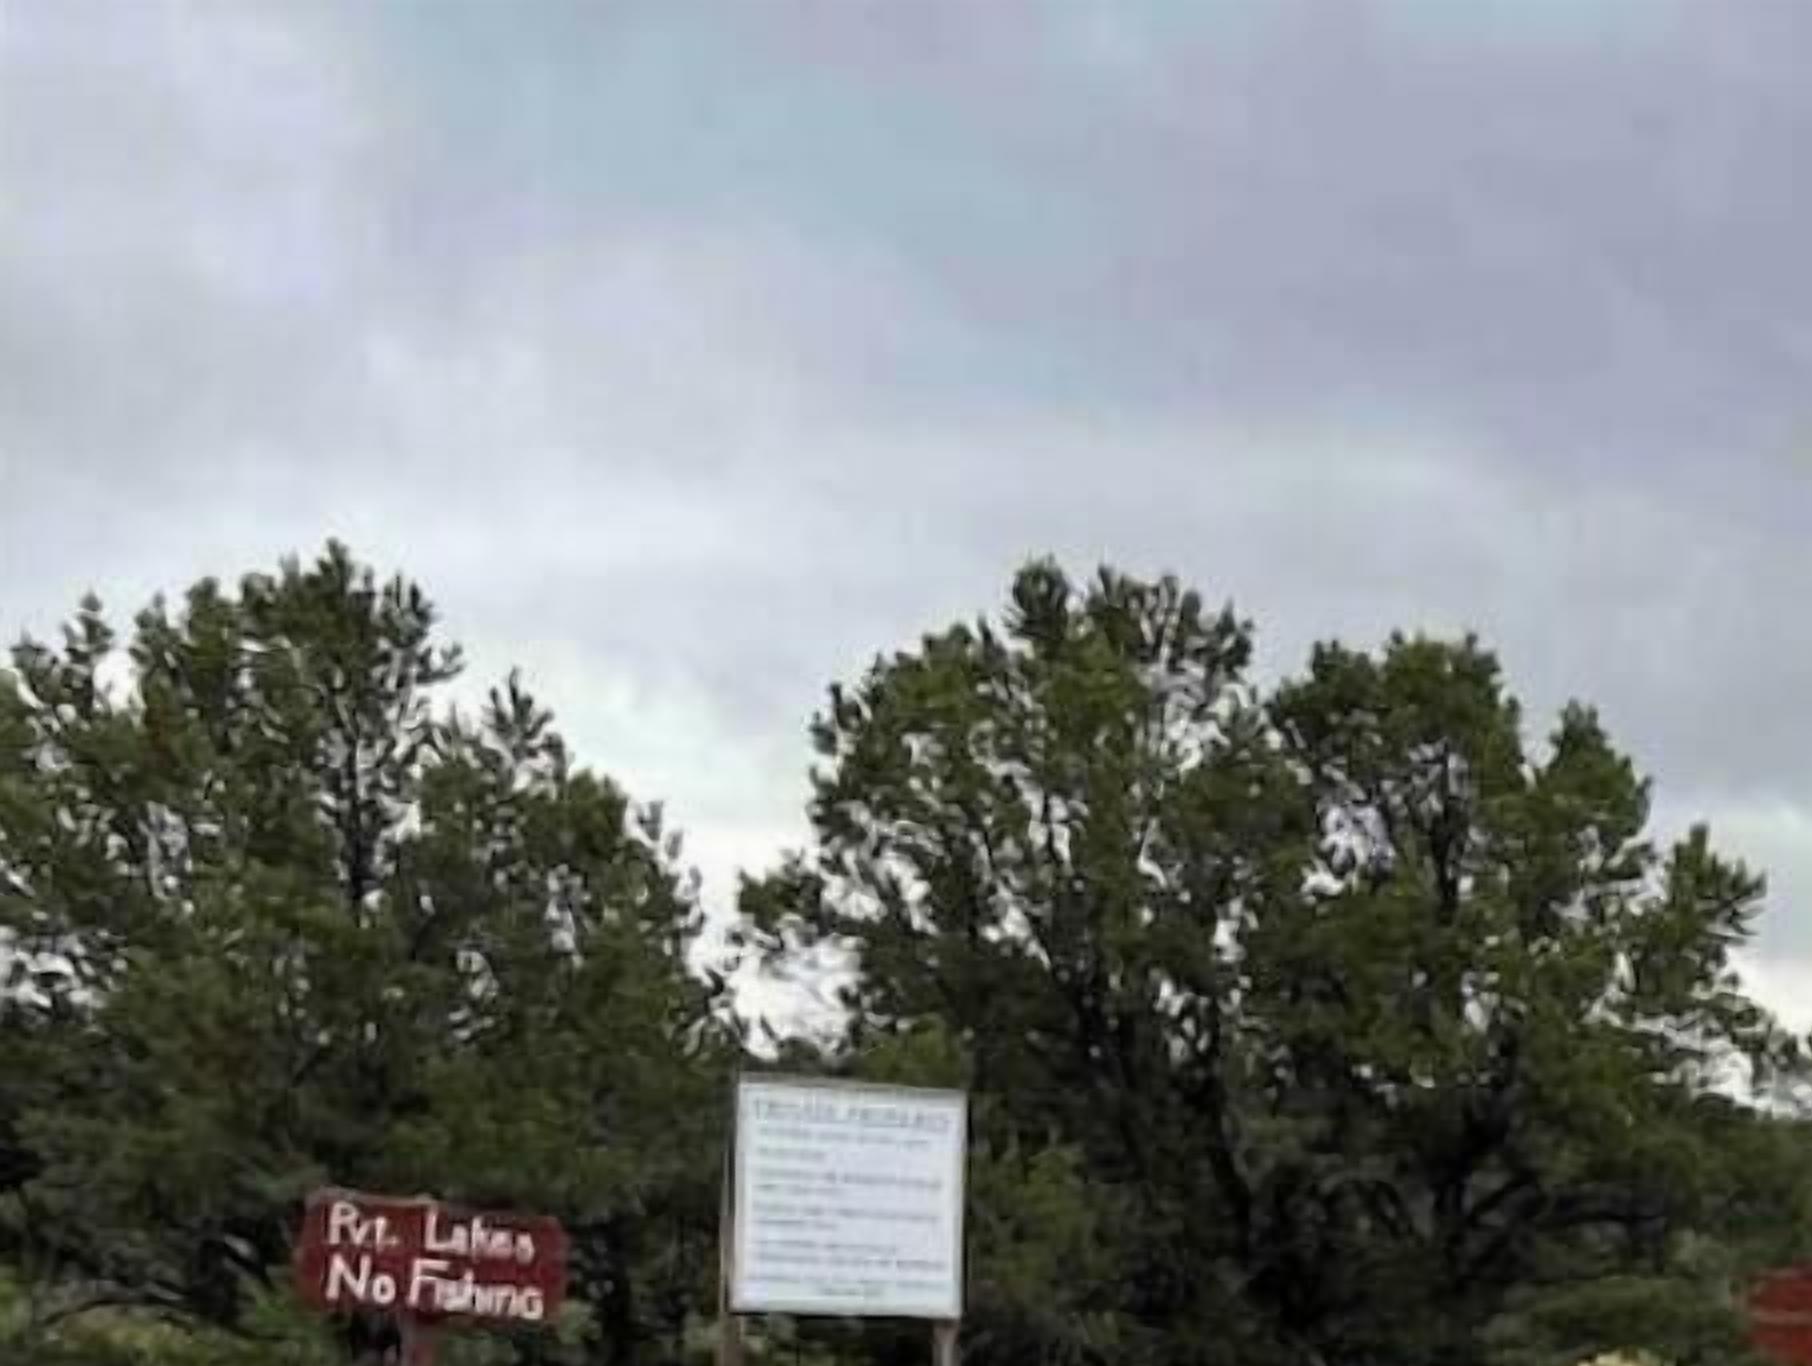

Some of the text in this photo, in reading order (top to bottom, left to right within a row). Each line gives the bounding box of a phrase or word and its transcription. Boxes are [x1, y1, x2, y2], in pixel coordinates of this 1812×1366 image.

[424, 1203, 535, 1264] Lakes
[325, 1253, 543, 1320] No Fishing
